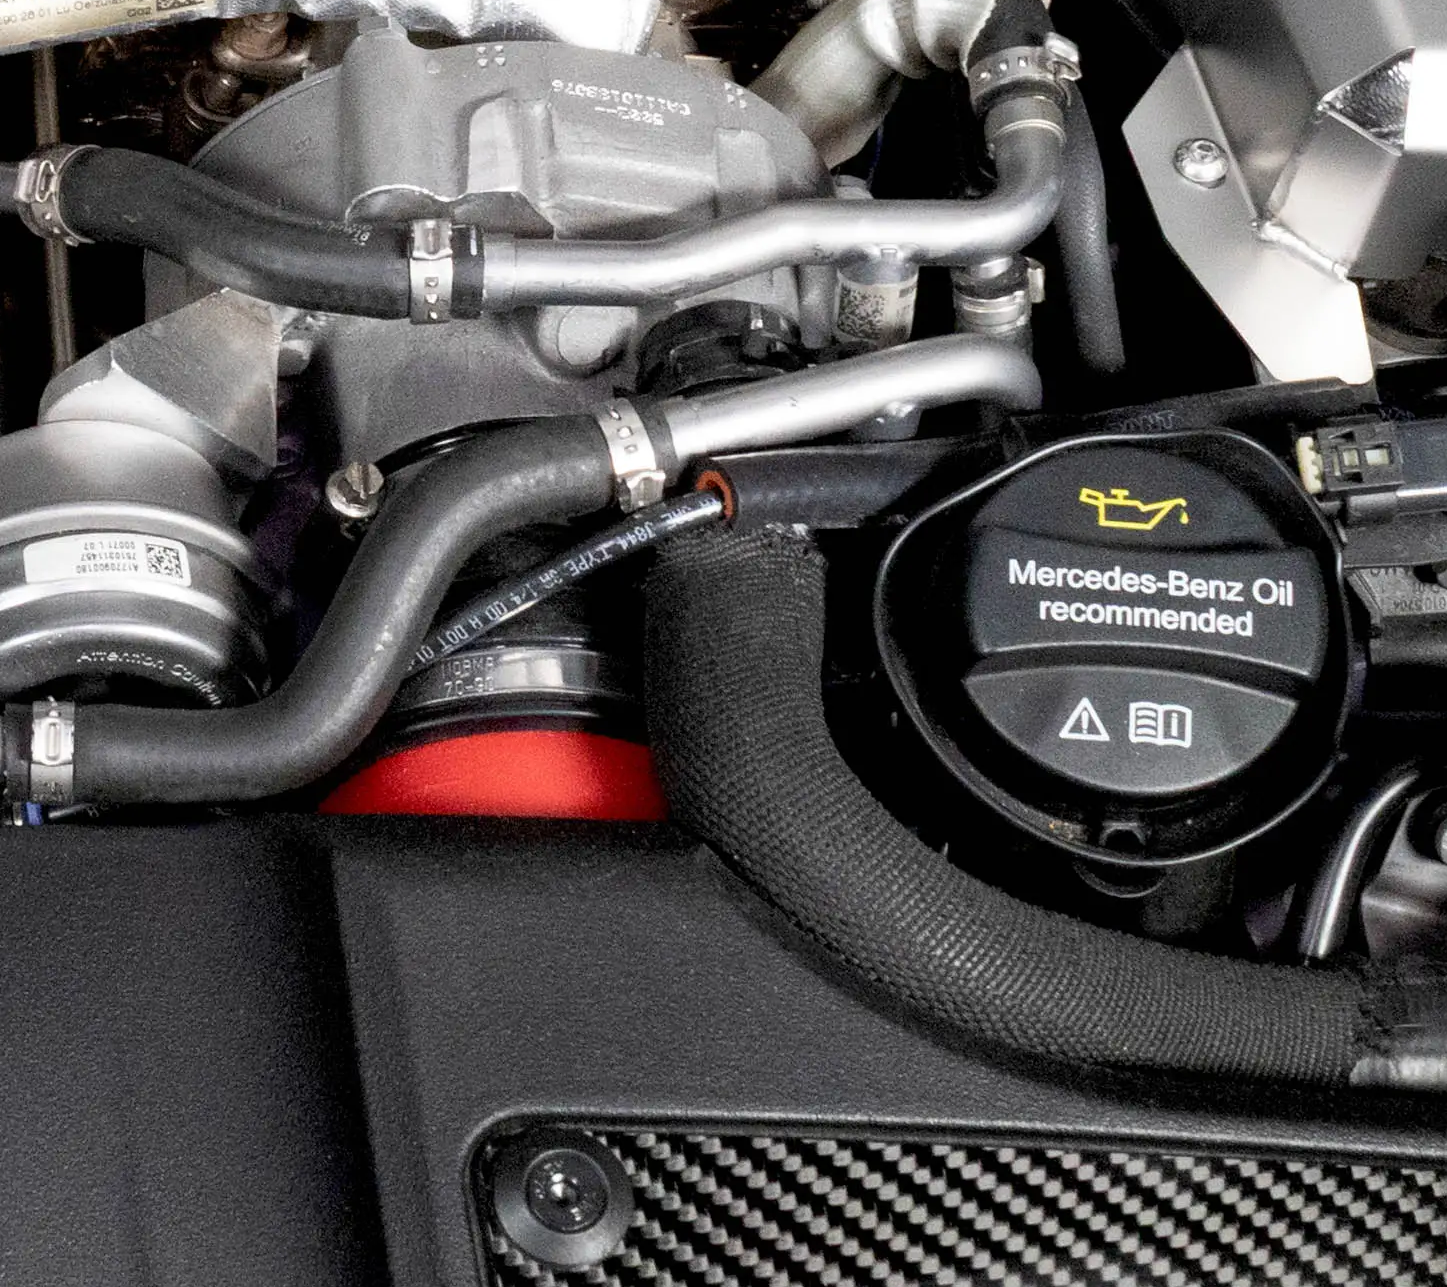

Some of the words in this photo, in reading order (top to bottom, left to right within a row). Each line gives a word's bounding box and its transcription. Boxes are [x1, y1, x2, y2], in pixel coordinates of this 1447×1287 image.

[1008, 558, 1244, 602] Mercedes-Benz
[1252, 577, 1294, 607] Oil
[1038, 599, 1254, 637] recommended
